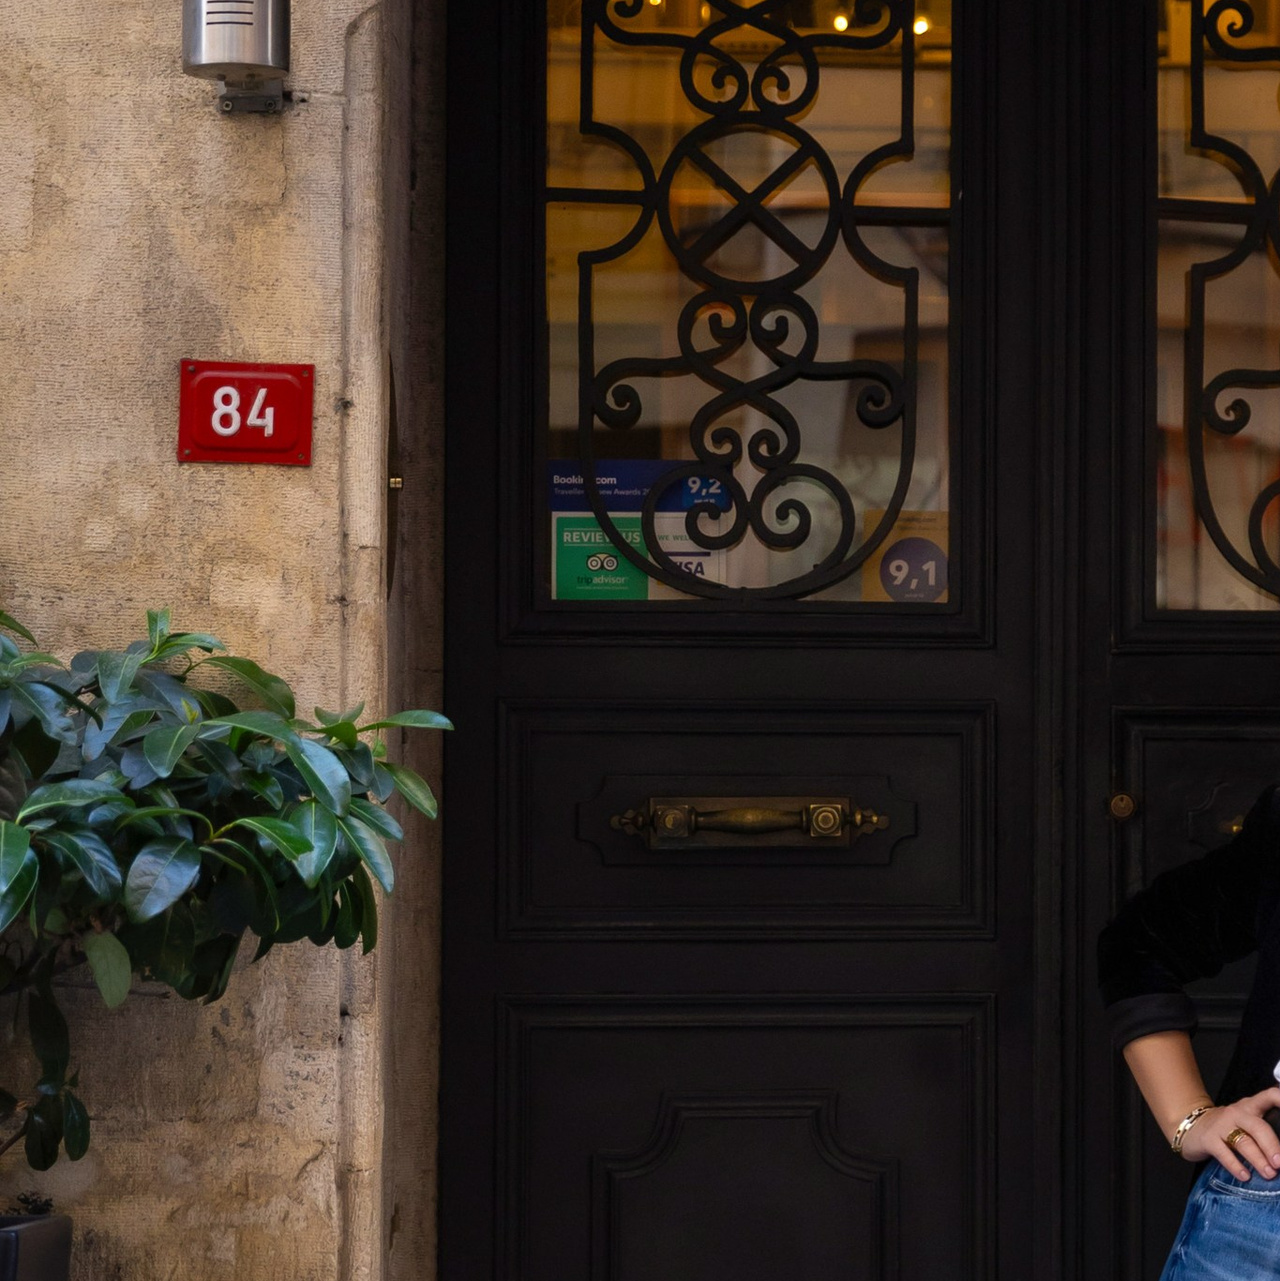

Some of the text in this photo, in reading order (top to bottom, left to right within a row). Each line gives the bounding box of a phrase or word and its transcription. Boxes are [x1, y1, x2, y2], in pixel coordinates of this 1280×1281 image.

[211, 385, 275, 438] 84
[687, 476, 722, 496] 9,2
[888, 559, 937, 589] 9,1
